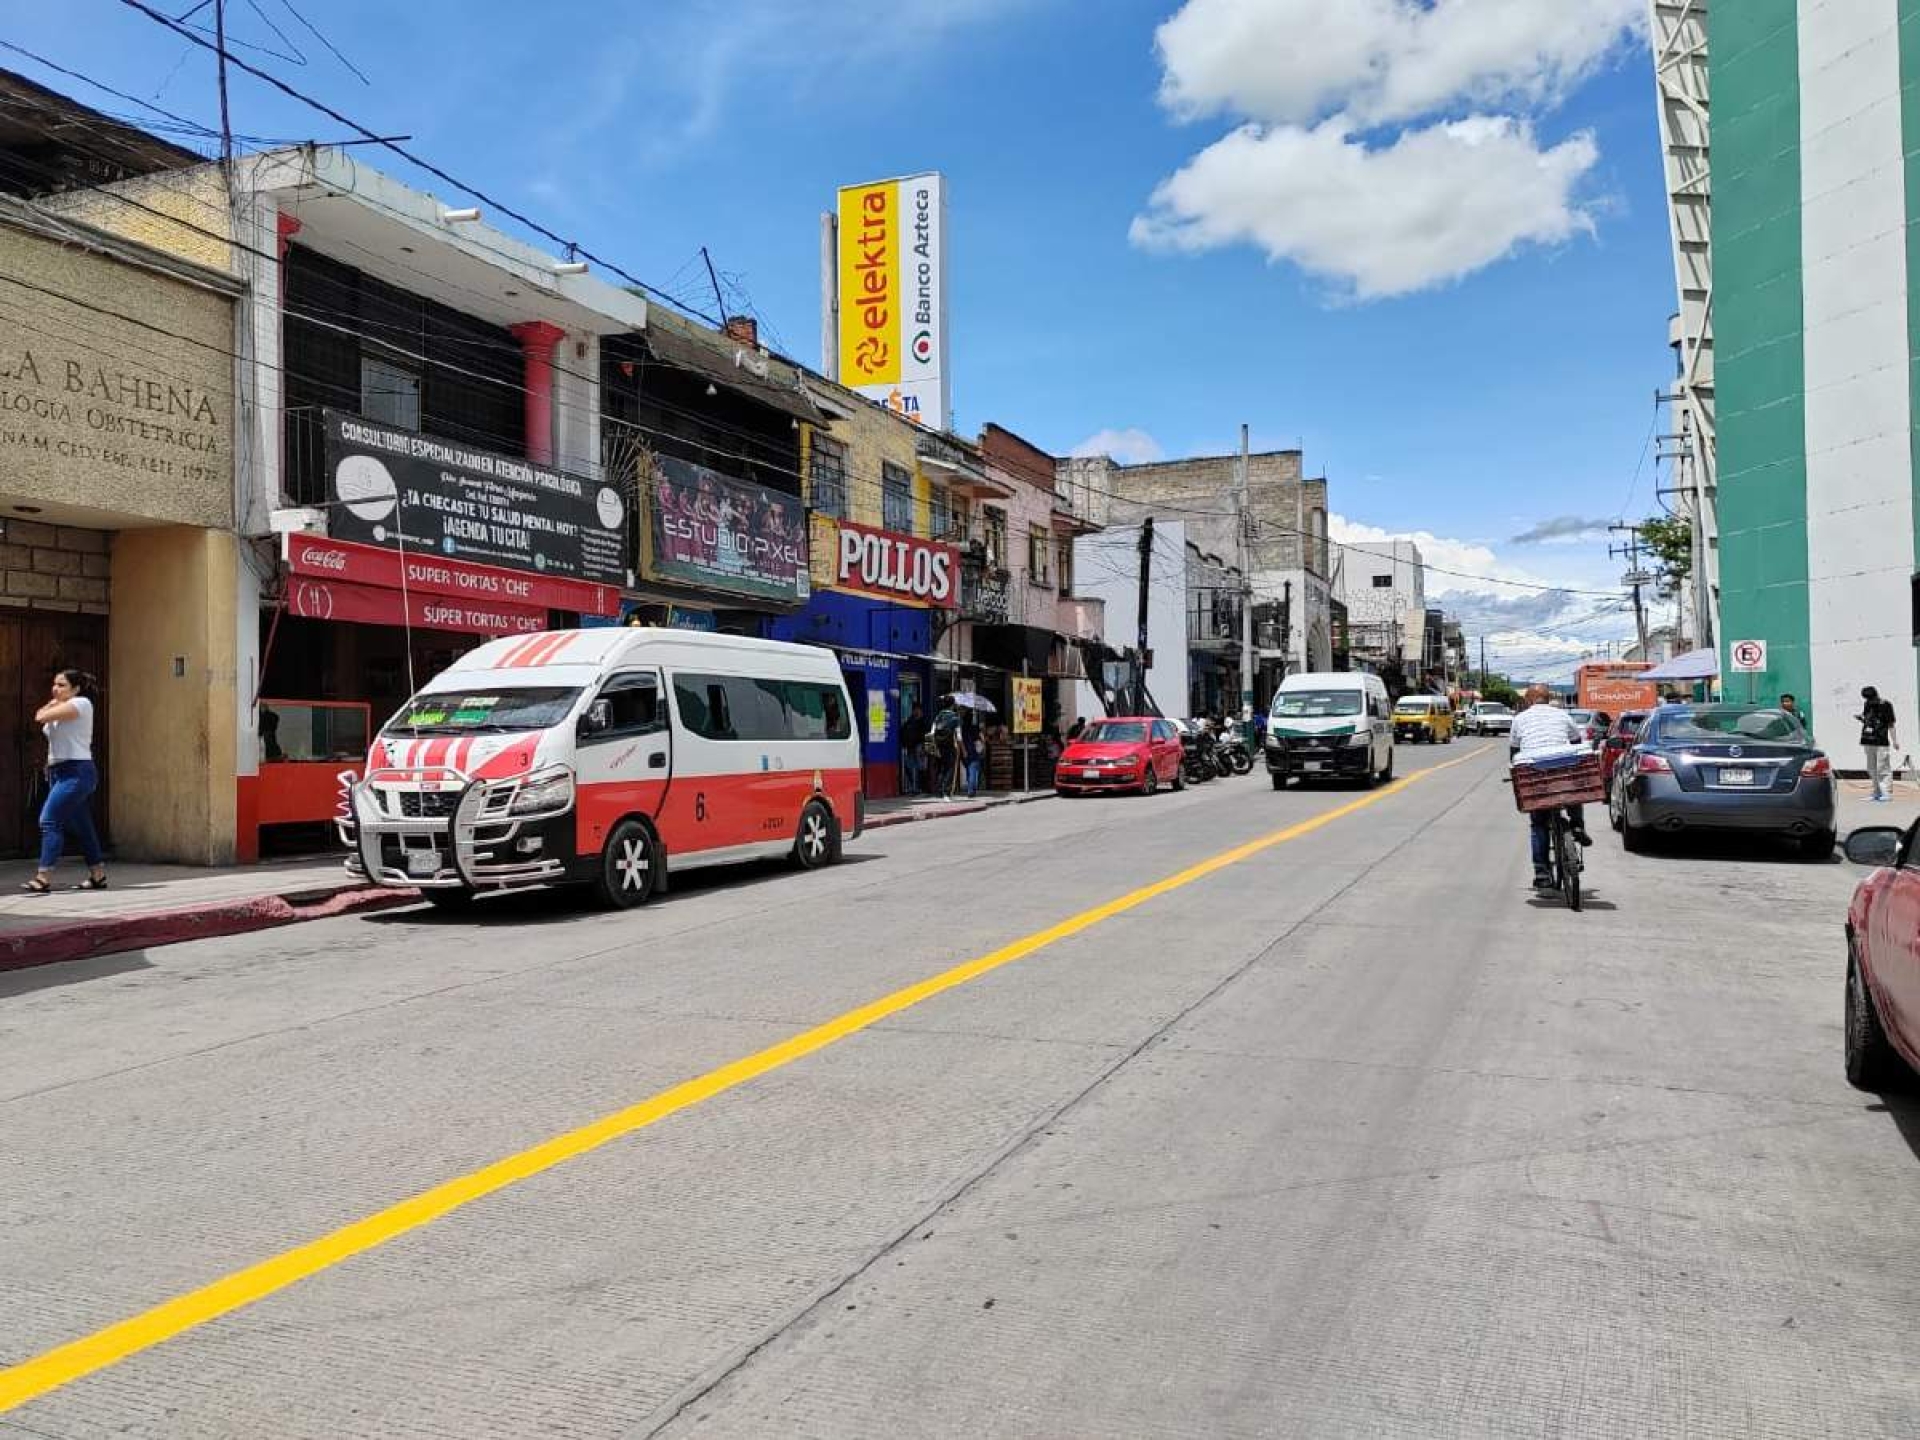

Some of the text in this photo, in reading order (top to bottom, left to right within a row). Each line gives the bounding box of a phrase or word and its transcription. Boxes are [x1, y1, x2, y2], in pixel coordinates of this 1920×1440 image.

[855, 191, 888, 330] elektra
[913, 188, 931, 324] Banco Azteca
[62, 359, 217, 424] BAHENA
[341, 421, 411, 455] CONSULTORIO
[423, 493, 476, 517] CHECASTE
[491, 506, 521, 527] SALUD
[522, 513, 556, 532] MENTAL
[663, 513, 750, 554] ESTUDIO
[408, 564, 451, 586] SUPER
[452, 572, 499, 592] TORTAS
[838, 528, 950, 600] POLLOS
[423, 605, 462, 626] SUPER
[465, 610, 508, 629] TORTAS
[1741, 647, 1754, 662] E
